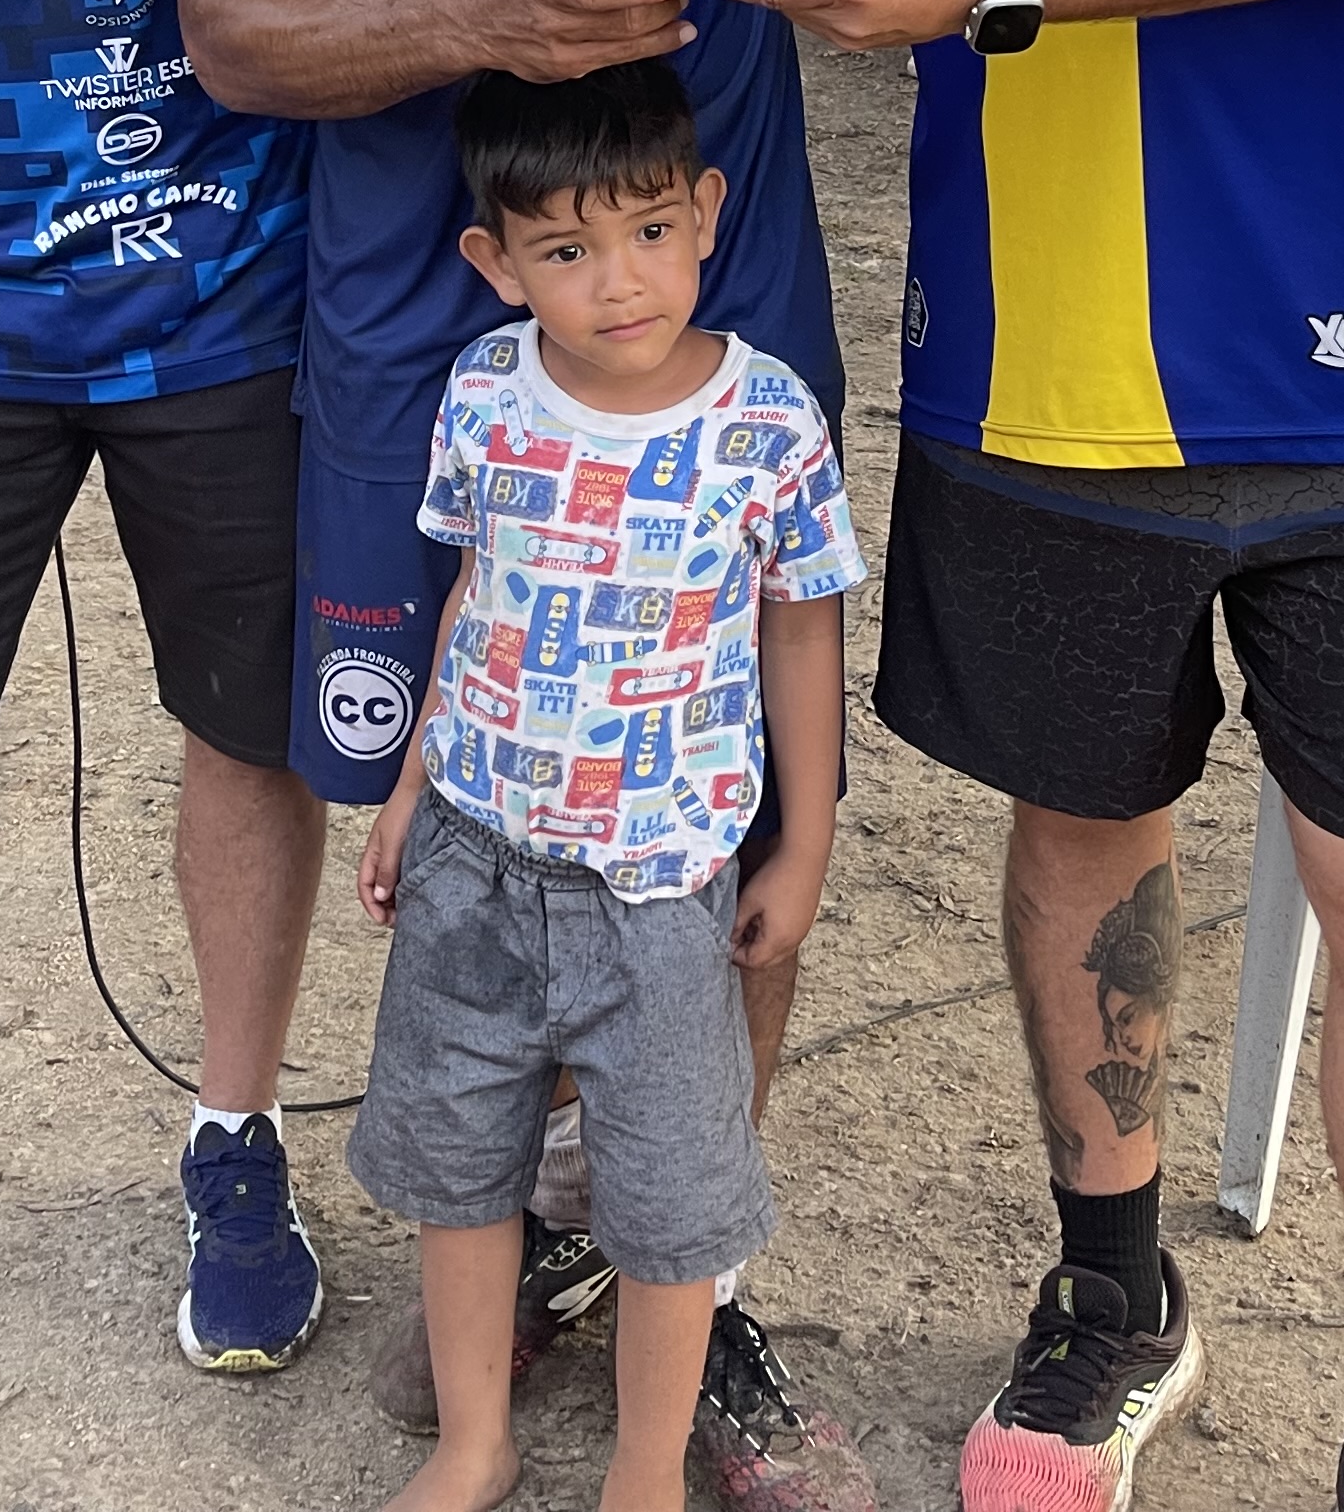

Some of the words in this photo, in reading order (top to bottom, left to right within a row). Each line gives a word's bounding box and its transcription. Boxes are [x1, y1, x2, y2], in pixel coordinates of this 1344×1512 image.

[39, 66, 154, 101] TWISTER
[74, 84, 176, 111] INFORMÁTICA
[80, 175, 118, 193] Disk
[33, 193, 139, 254] RANCHO
[146, 182, 238, 211] CANZIL
[111, 211, 184, 267] RR
[642, 532, 683, 552] IT!
[353, 647, 417, 687] FRONTEIRA
[330, 693, 397, 726] CC
[537, 695, 574, 714] IT!
